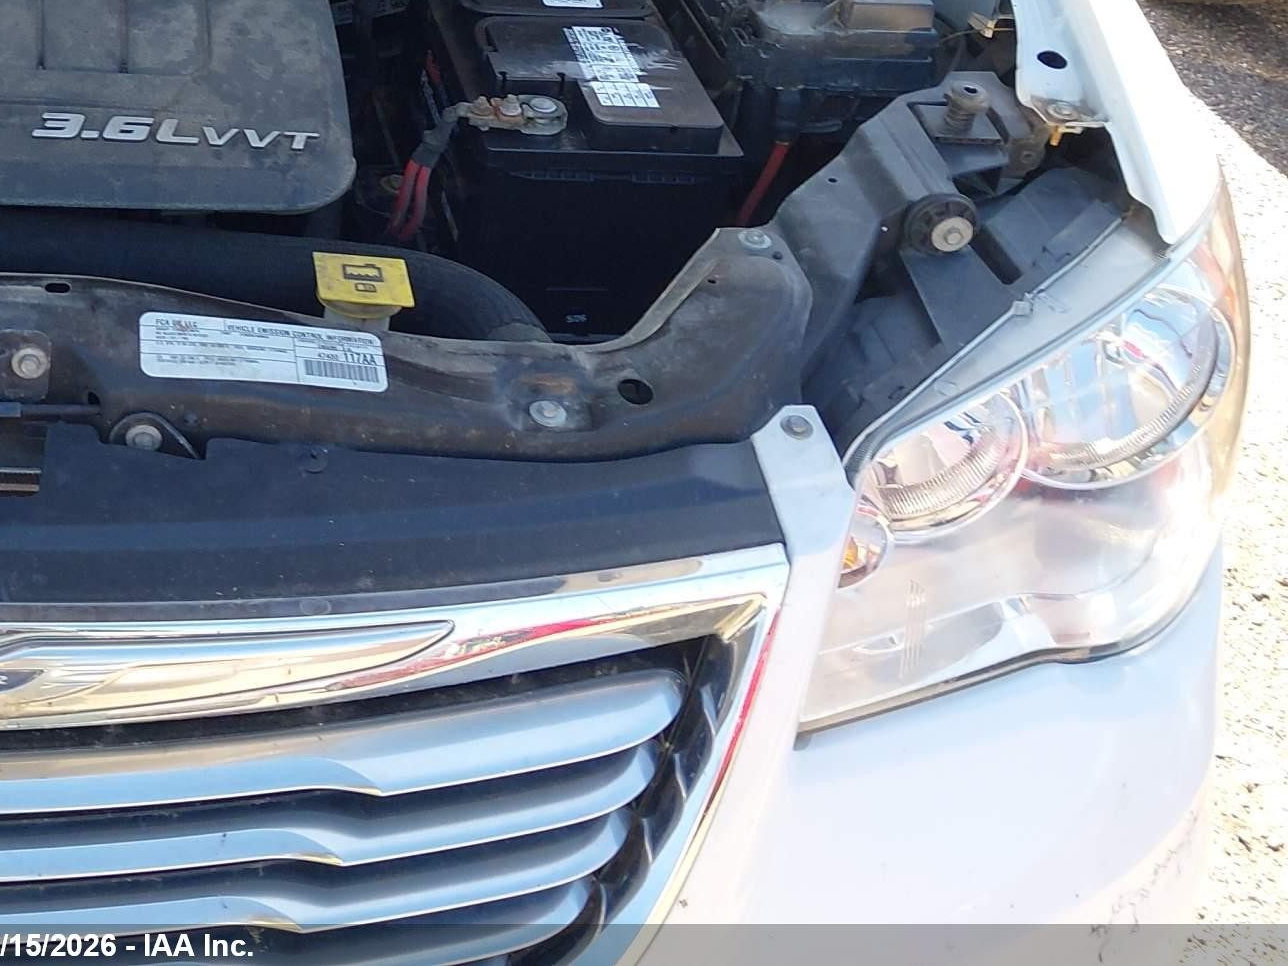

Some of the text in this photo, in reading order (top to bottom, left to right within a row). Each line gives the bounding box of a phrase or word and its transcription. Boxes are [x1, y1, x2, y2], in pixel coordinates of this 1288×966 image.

[155, 318, 170, 326] FCA
[226, 324, 255, 333] VEHICLE
[257, 327, 290, 337] EMISSION
[292, 330, 324, 340] CONTROL
[325, 334, 373, 344] INFORMATION
[344, 352, 377, 366] 117AA
